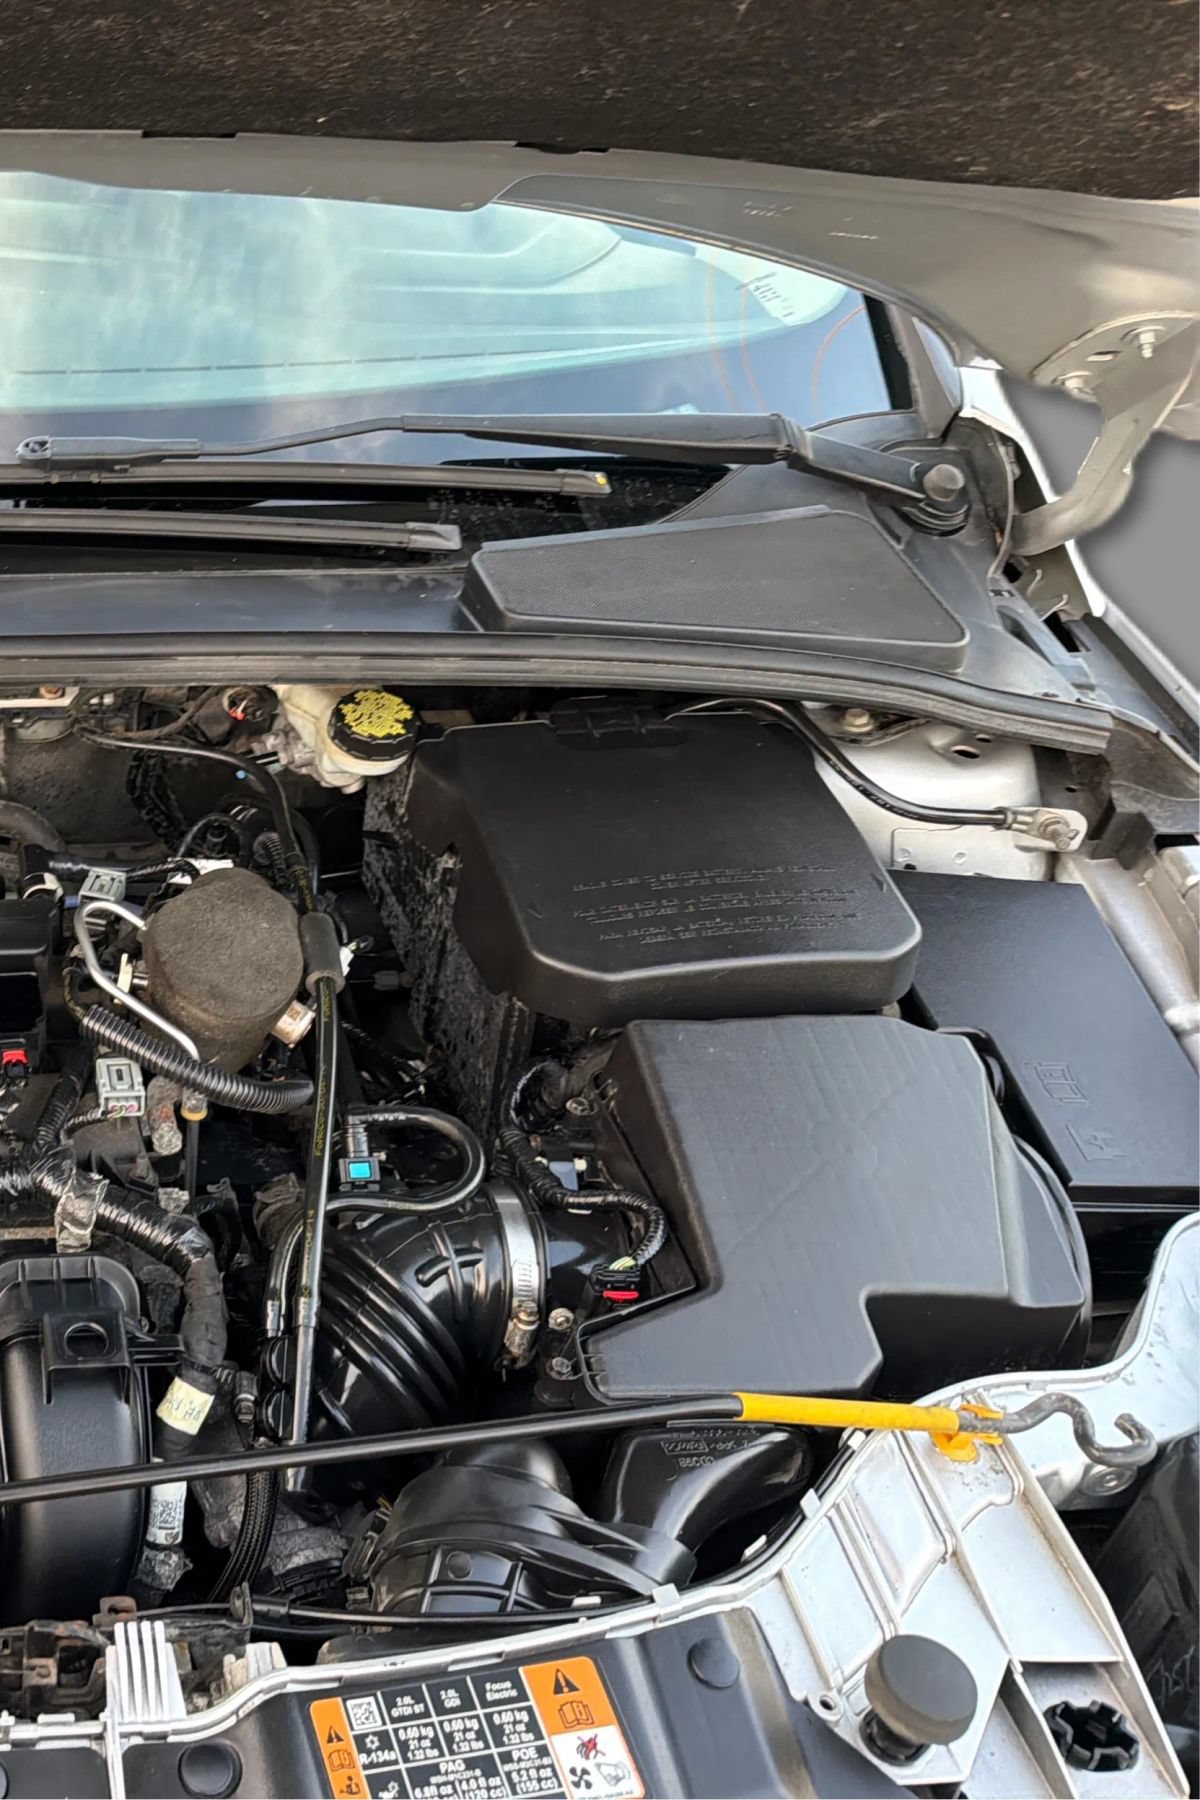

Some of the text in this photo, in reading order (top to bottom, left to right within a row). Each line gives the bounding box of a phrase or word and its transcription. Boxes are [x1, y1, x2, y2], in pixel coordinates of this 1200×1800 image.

[485, 1680, 512, 1691] Focus
[440, 1688, 459, 1700] 2.0L
[486, 1688, 518, 1701] Electric
[396, 1695, 415, 1706] 2.0L
[444, 1697, 461, 1708] GDI
[391, 1703, 424, 1717] GTDI ST
[493, 1709, 529, 1725] 0.60 kg
[443, 1717, 479, 1733] 0.60 kg
[503, 1722, 527, 1735] 21 oz
[398, 1725, 434, 1741] 0.60 kg
[453, 1730, 476, 1742] 21 oz
[520, 1732, 535, 1742] lbs
[408, 1738, 432, 1750] 21 oz
[470, 1740, 484, 1750] lbs
[359, 1749, 397, 1765] R-134a
[425, 1747, 439, 1758] lbs
[511, 1746, 539, 1761] POE
[439, 1759, 466, 1774] PAG
[539, 1767, 553, 1778] oz
[488, 1775, 502, 1788] oz
[516, 1776, 558, 1794] (155 cc)
[439, 1784, 454, 1796] oz
